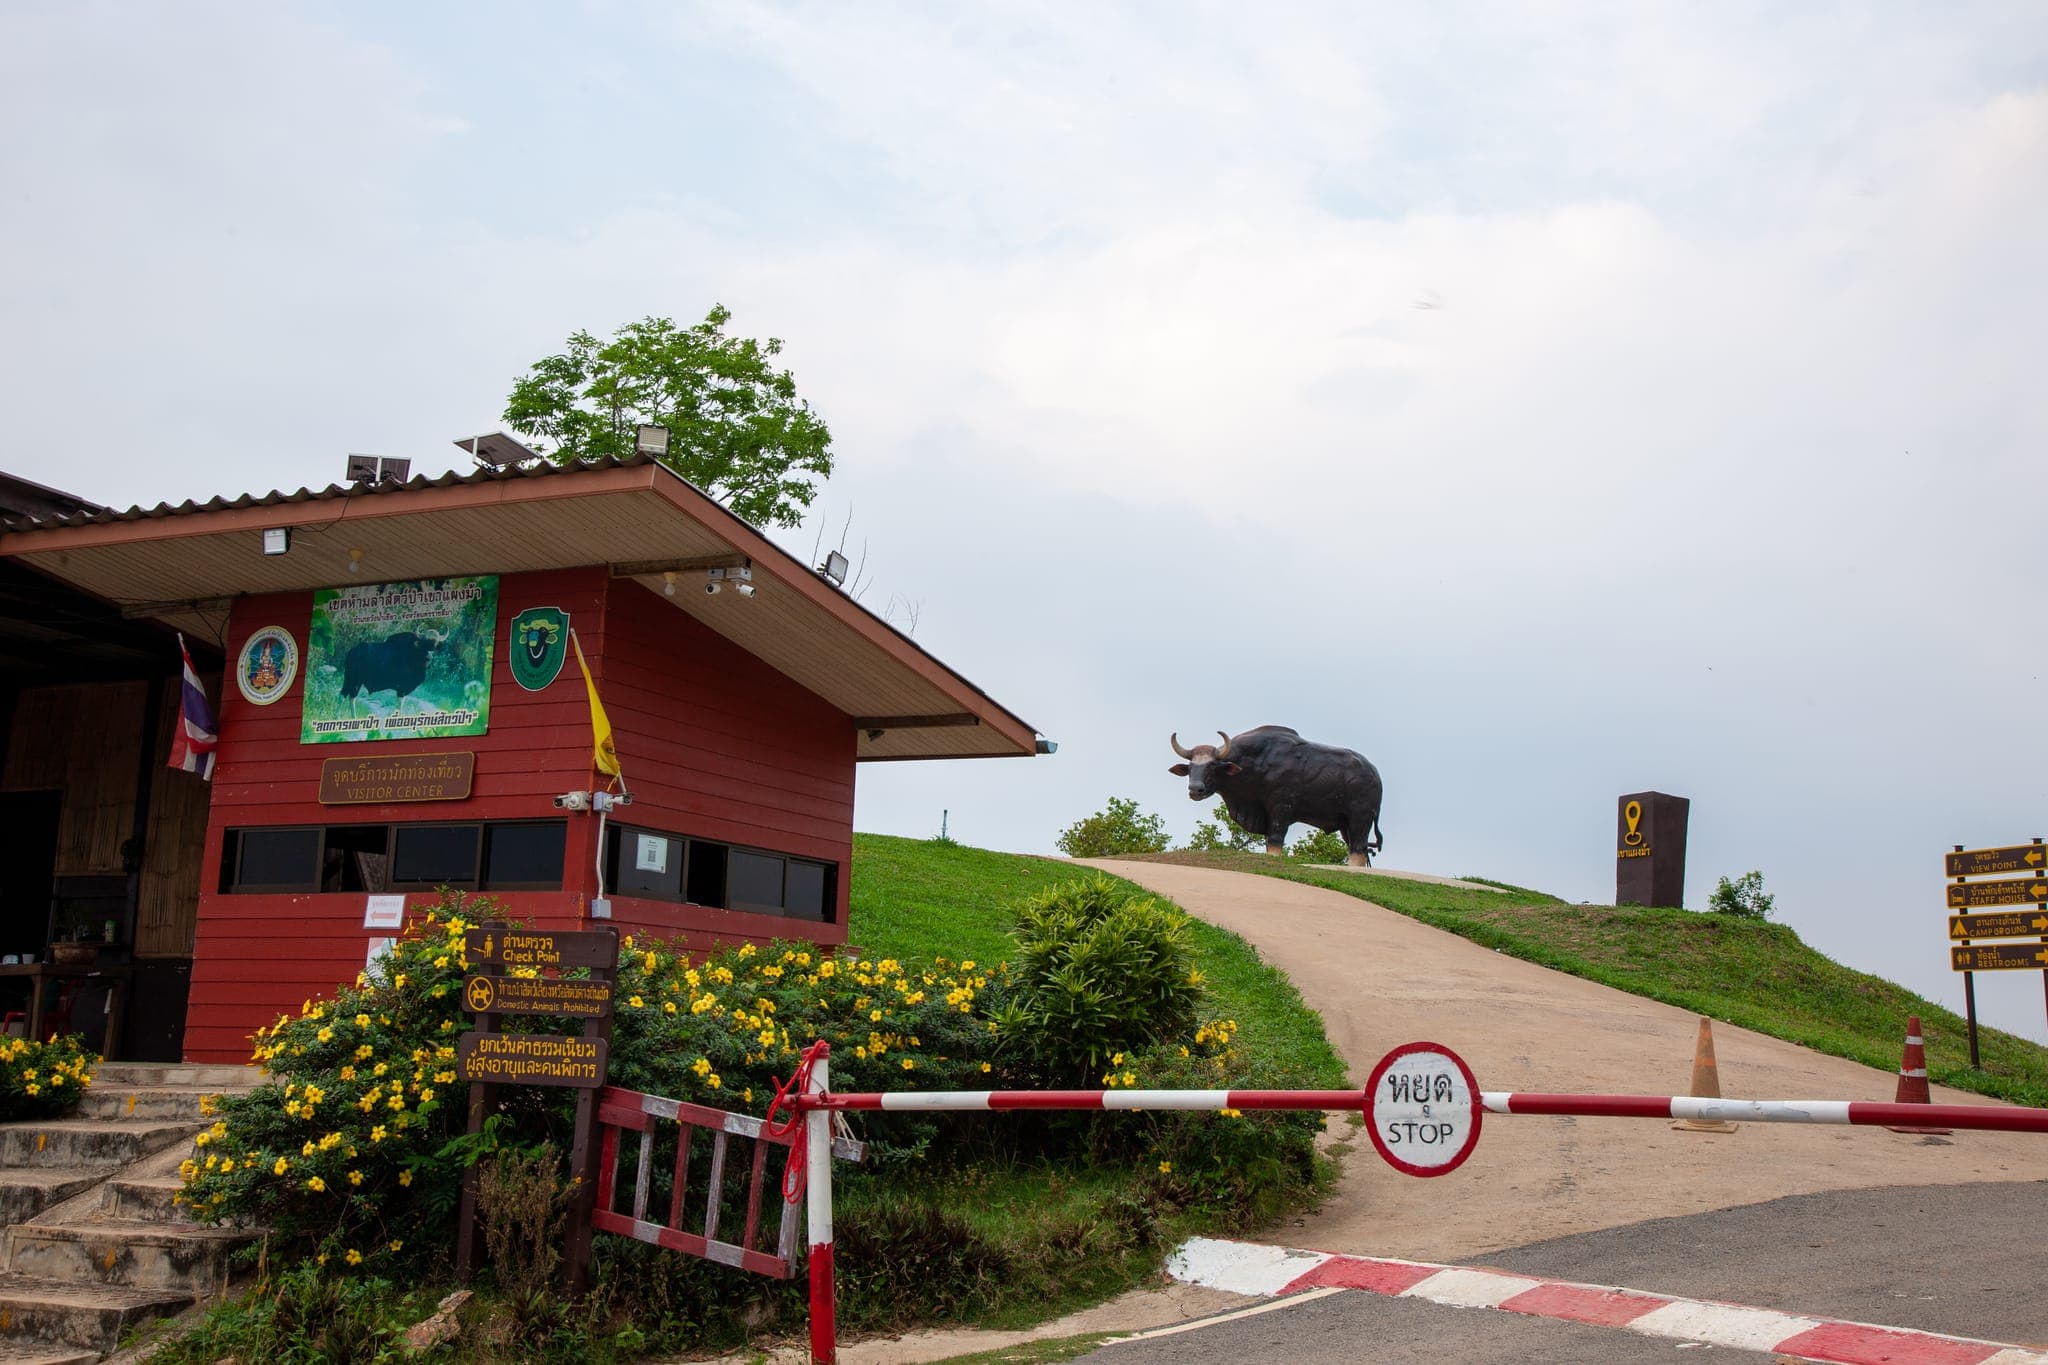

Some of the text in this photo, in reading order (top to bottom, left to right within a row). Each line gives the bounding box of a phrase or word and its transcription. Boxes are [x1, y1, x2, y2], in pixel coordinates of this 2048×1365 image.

[329, 585, 482, 611] เขตห้ามล่าสัตว์ป่าเขาแผงม้า
[333, 756, 462, 788] จุดบริการนักท่องเที่ยว
[347, 784, 444, 800] VISITOR CENTER
[1970, 861, 2017, 873] VIEW POINT
[1970, 895, 2026, 905] STAFF HOUSE
[1969, 925, 2028, 937] CAMPGROUND
[503, 932, 553, 950] ด่านตรวจ
[502, 949, 560, 963] Check Point
[1977, 958, 2029, 968] RESTROOMS
[497, 998, 601, 1013] Domestic Animals Prohibited
[479, 1033, 597, 1057] ยกเว้นค่าธรรมเนียม
[466, 1049, 597, 1079] ผู้สูงอายุและคนพิการ
[1388, 1073, 1453, 1118] หยุด
[1388, 1122, 1454, 1145] STOP
